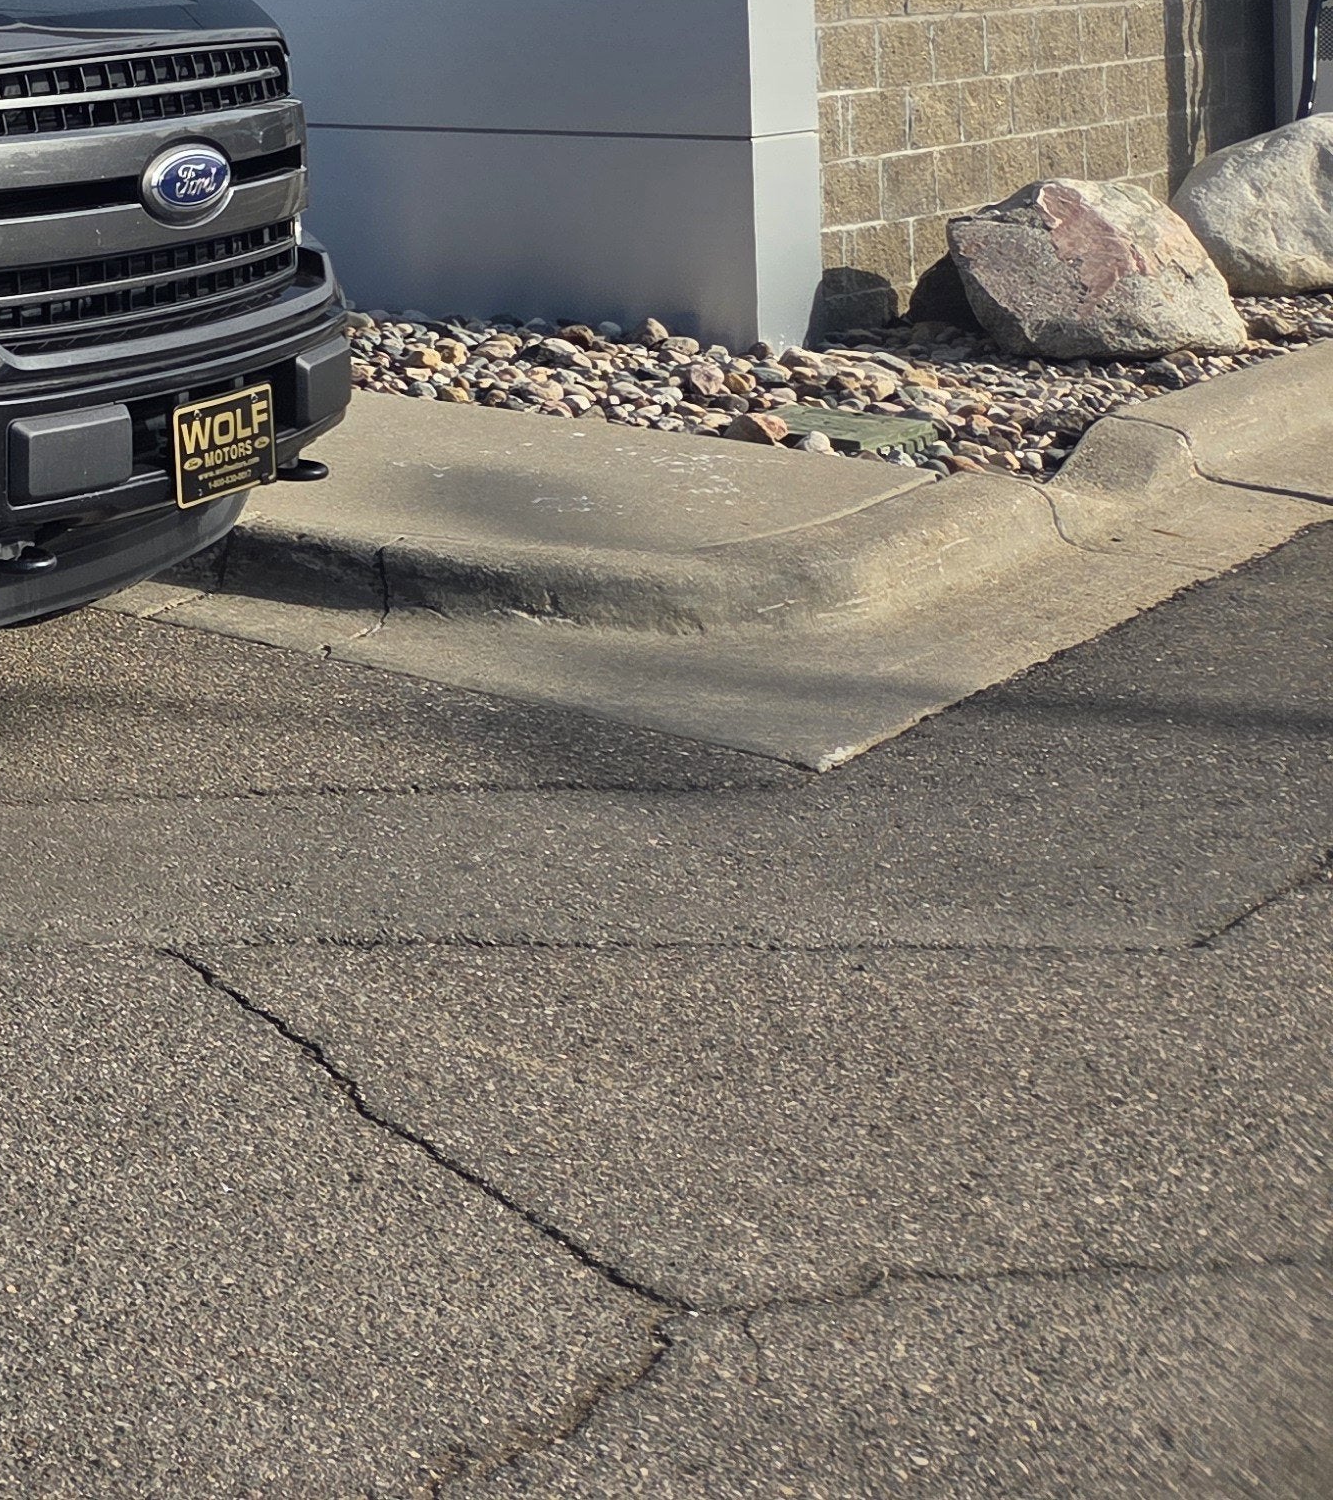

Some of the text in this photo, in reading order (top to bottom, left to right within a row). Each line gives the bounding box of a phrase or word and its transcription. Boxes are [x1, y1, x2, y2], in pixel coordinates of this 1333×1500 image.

[175, 163, 217, 199] Ford
[180, 400, 269, 455] WOLF
[204, 439, 253, 468] MOTORS
